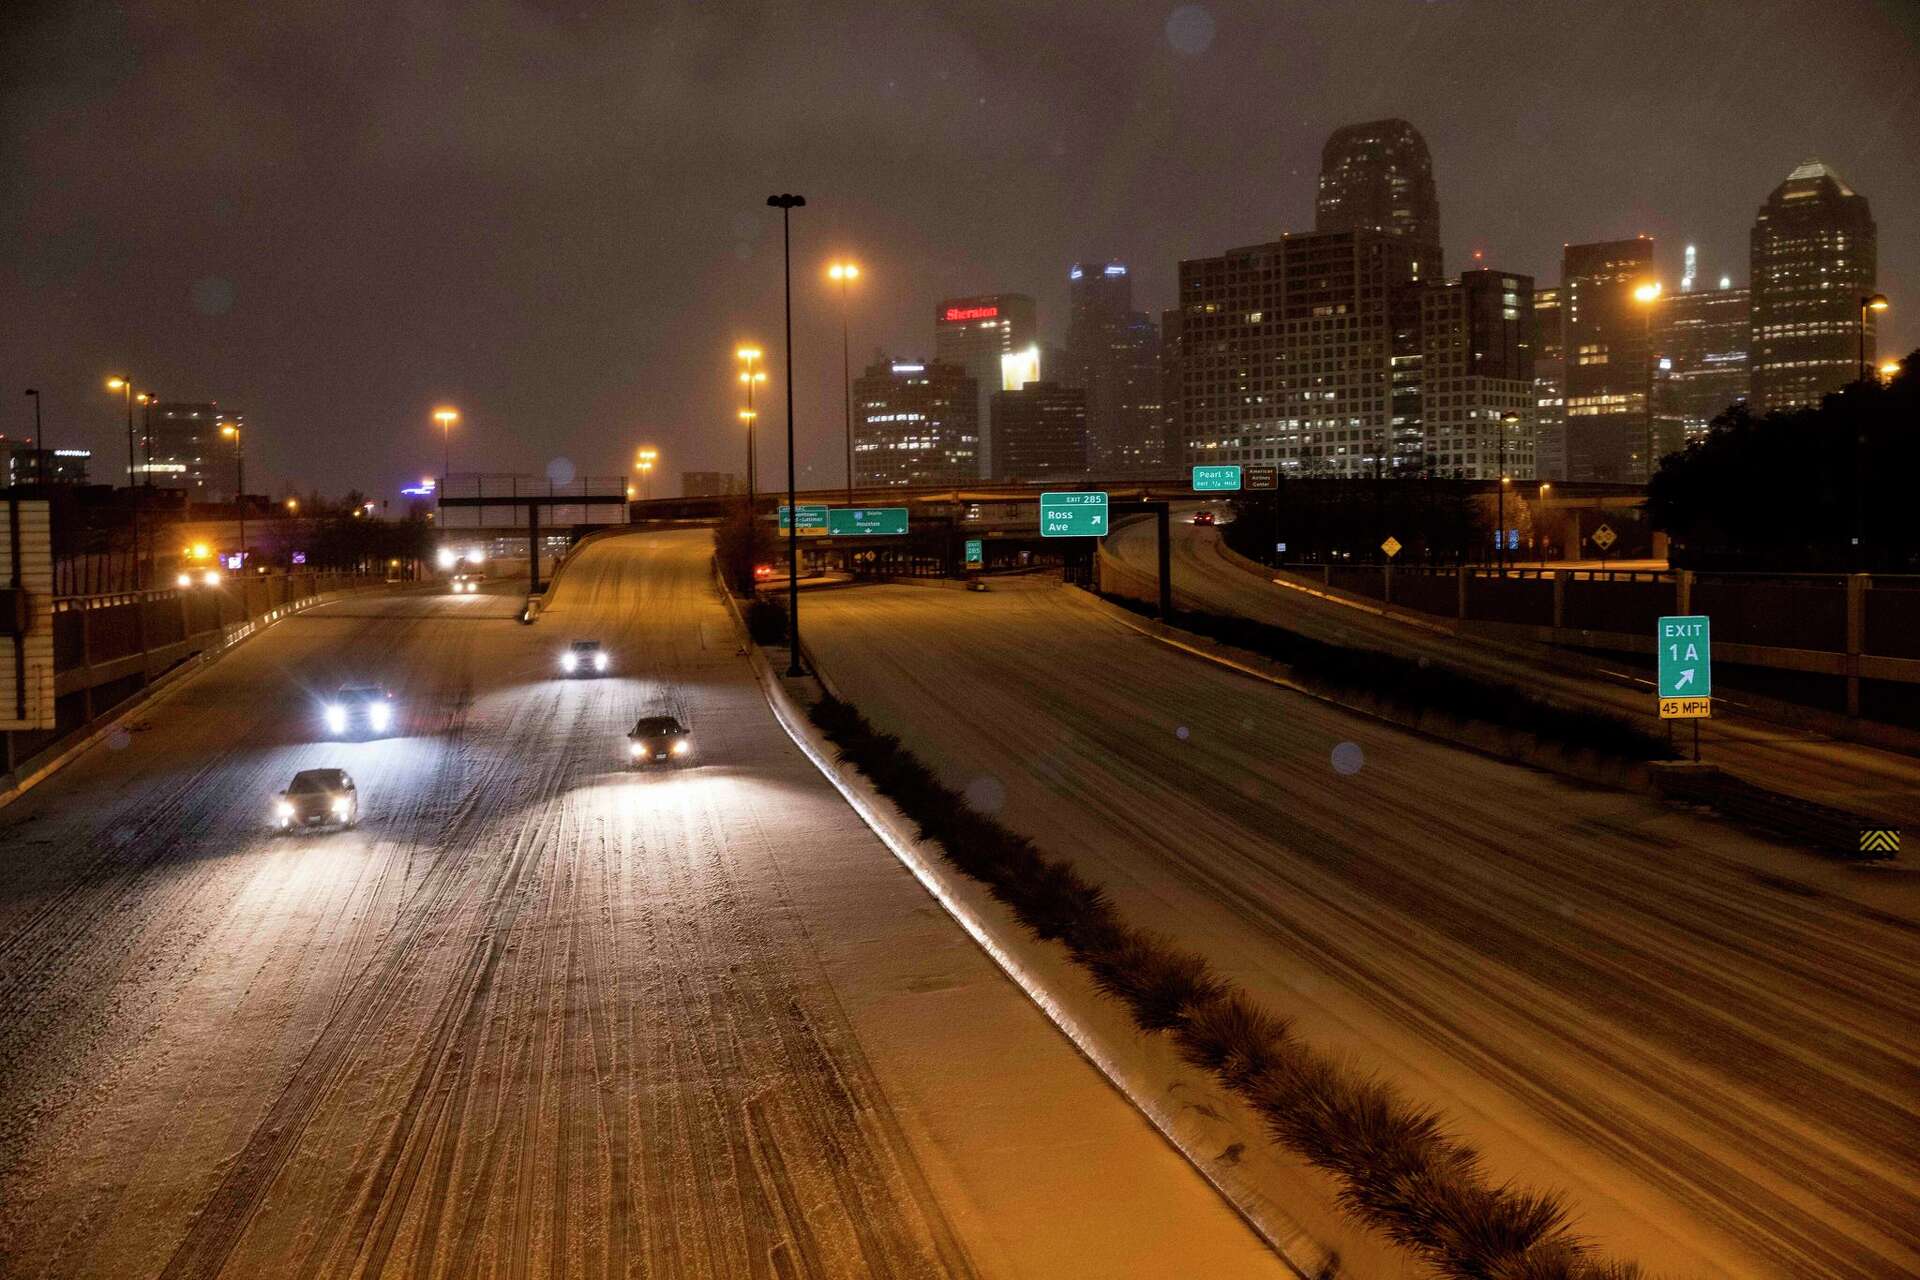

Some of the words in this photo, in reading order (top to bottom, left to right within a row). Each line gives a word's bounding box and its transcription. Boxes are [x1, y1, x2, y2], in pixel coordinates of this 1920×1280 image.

[946, 307, 998, 321] Sheraton
[1084, 495, 1102, 503] 285
[1048, 511, 1073, 519] Ross
[1048, 523, 1069, 531] Ave
[1665, 624, 1702, 637] EXIT
[1662, 702, 1679, 715] 45
[1682, 702, 1709, 714] MPH
